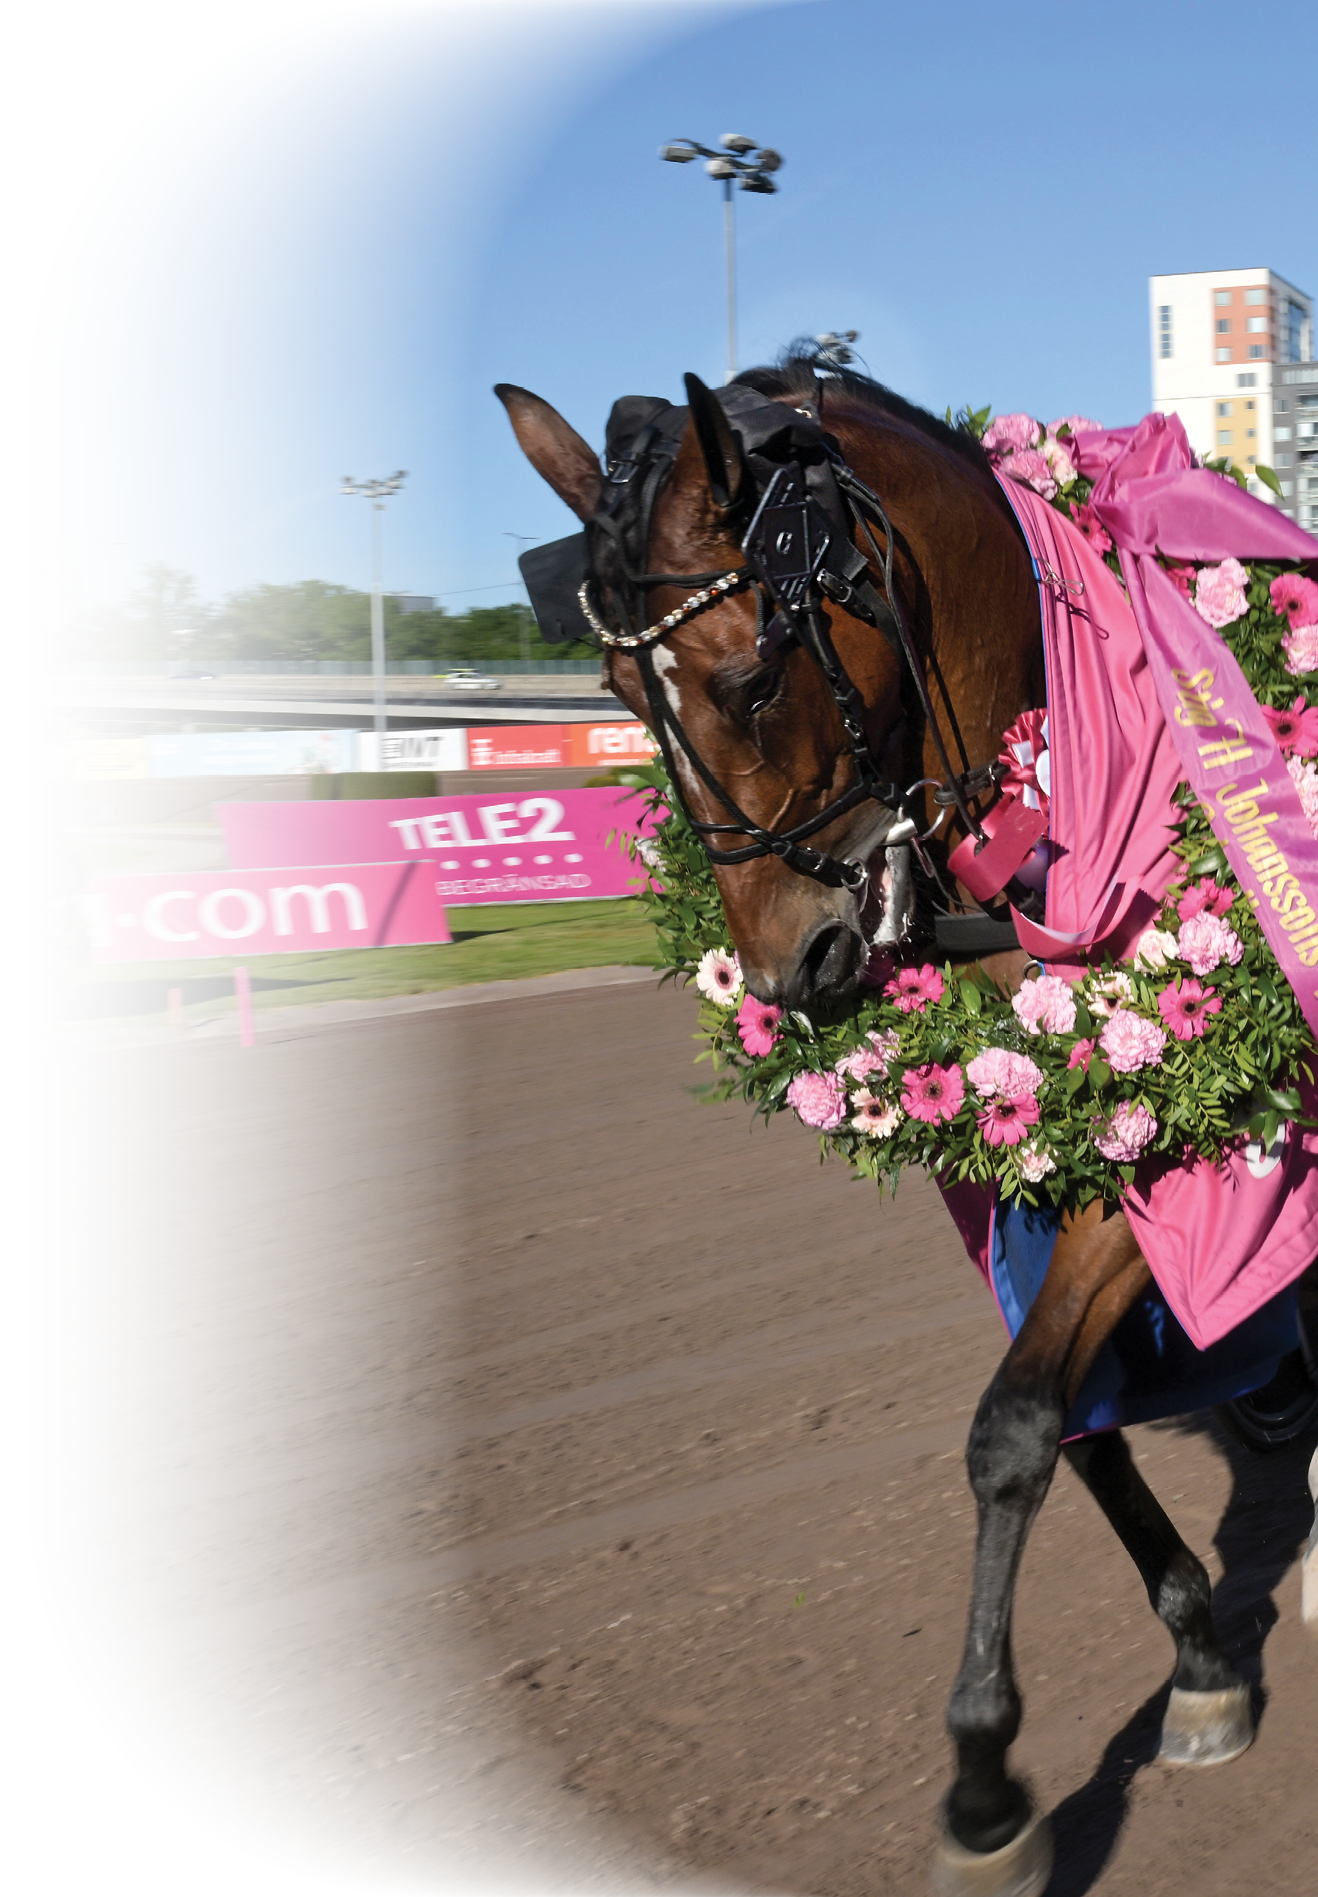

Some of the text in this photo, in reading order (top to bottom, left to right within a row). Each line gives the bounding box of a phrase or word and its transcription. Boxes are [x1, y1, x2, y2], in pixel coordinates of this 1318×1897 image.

[1171, 667, 1225, 728] Stig
[1197, 718, 1253, 770] H
[388, 798, 577, 850] TELE2
